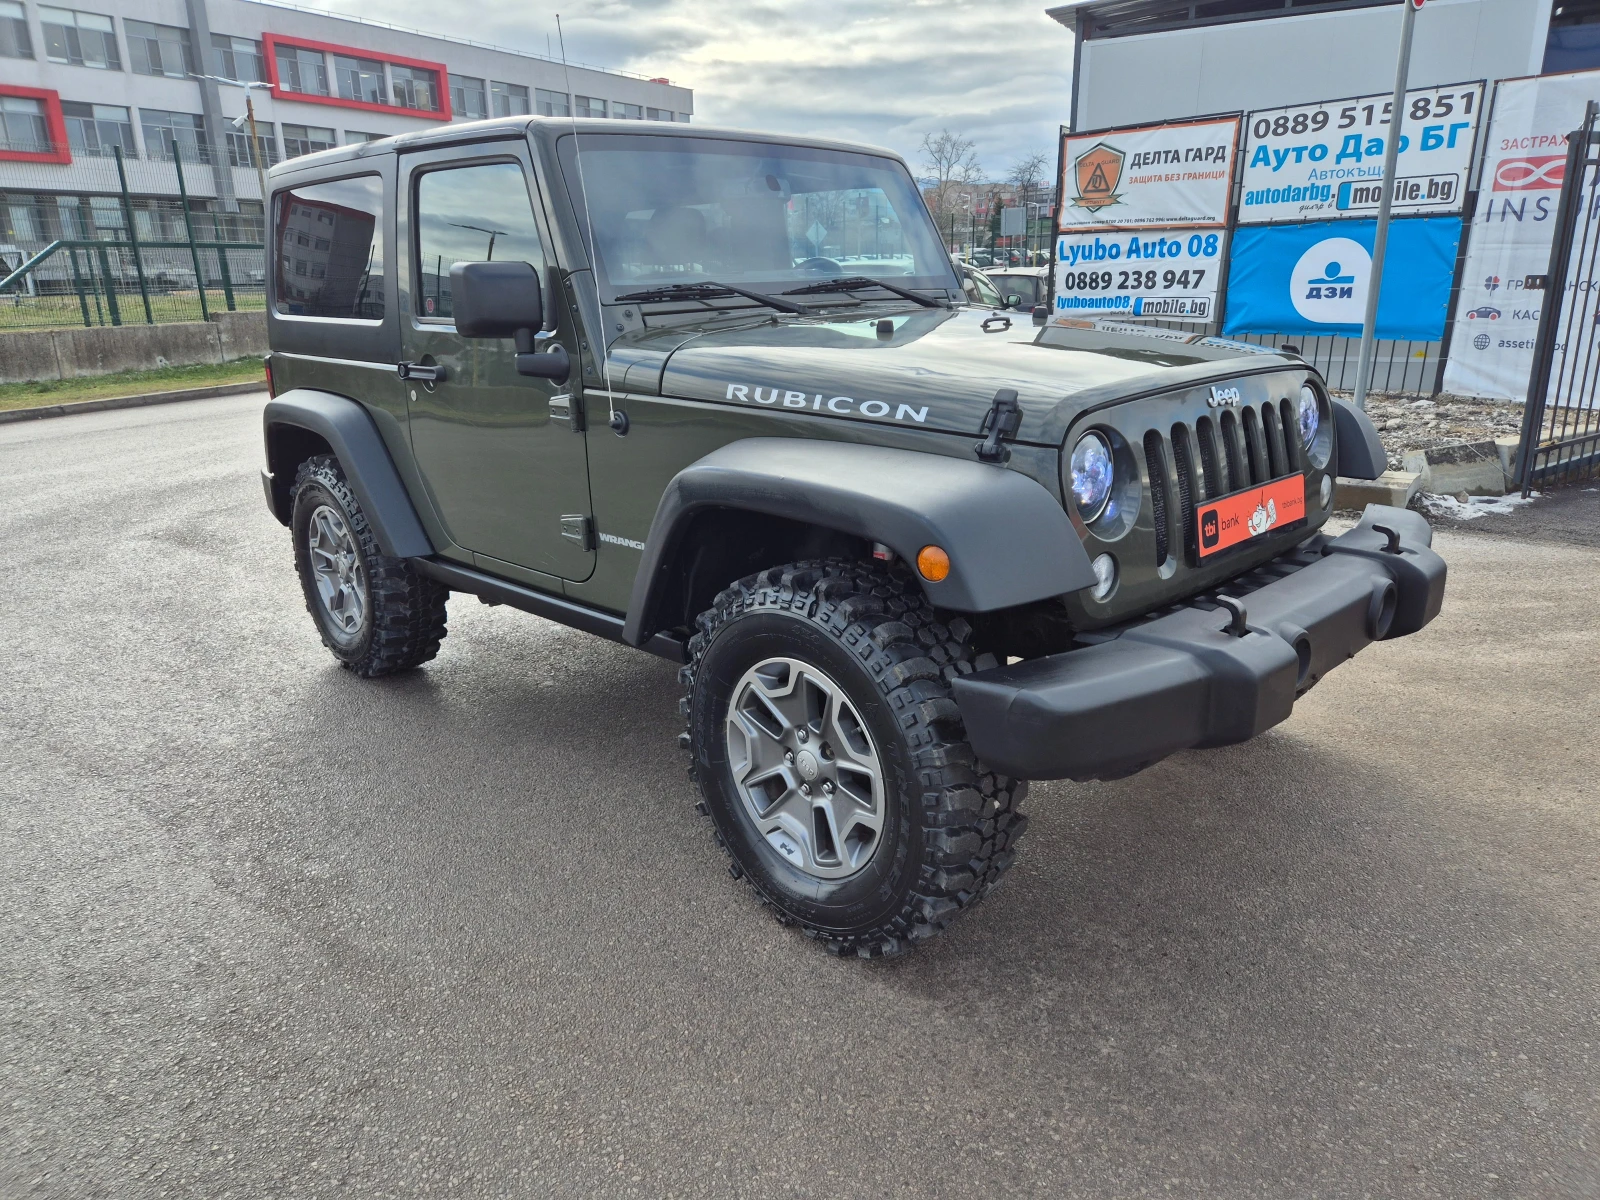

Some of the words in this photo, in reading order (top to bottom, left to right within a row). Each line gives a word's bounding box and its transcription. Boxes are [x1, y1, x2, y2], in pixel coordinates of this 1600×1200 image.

[1253, 110, 1329, 139] 0889
[1337, 102, 1393, 130] 515
[1409, 91, 1475, 121] 851
[1250, 143, 1328, 172] Ауто
[1419, 122, 1470, 151] БГ
[1500, 134, 1568, 151] ЗАСТРАХ
[1130, 150, 1181, 170] ДЕЛТА
[1184, 145, 1227, 163] ГАРД
[1128, 174, 1163, 185] ЗАЩИТА
[1164, 172, 1181, 182] БЕЗ
[1182, 170, 1226, 181] ГРАНИЦИ
[1307, 165, 1385, 181] Автокъщ
[1352, 178, 1453, 204] moile.bg
[1059, 238, 1121, 267] Lyubo
[1126, 236, 1183, 260] Auto
[1187, 233, 1219, 257] 08
[1065, 271, 1113, 291] 0889
[1117, 270, 1157, 290] 238
[1163, 269, 1206, 290] 947
[1305, 286, 1353, 300] ДЗИ
[1142, 297, 1207, 317] mobile.bg
[1512, 309, 1541, 321] КАС
[725, 383, 929, 423] RUBICON
[1208, 386, 1240, 407] Jeep
[1204, 520, 1217, 537] tbi
[1221, 513, 1240, 531] bank
